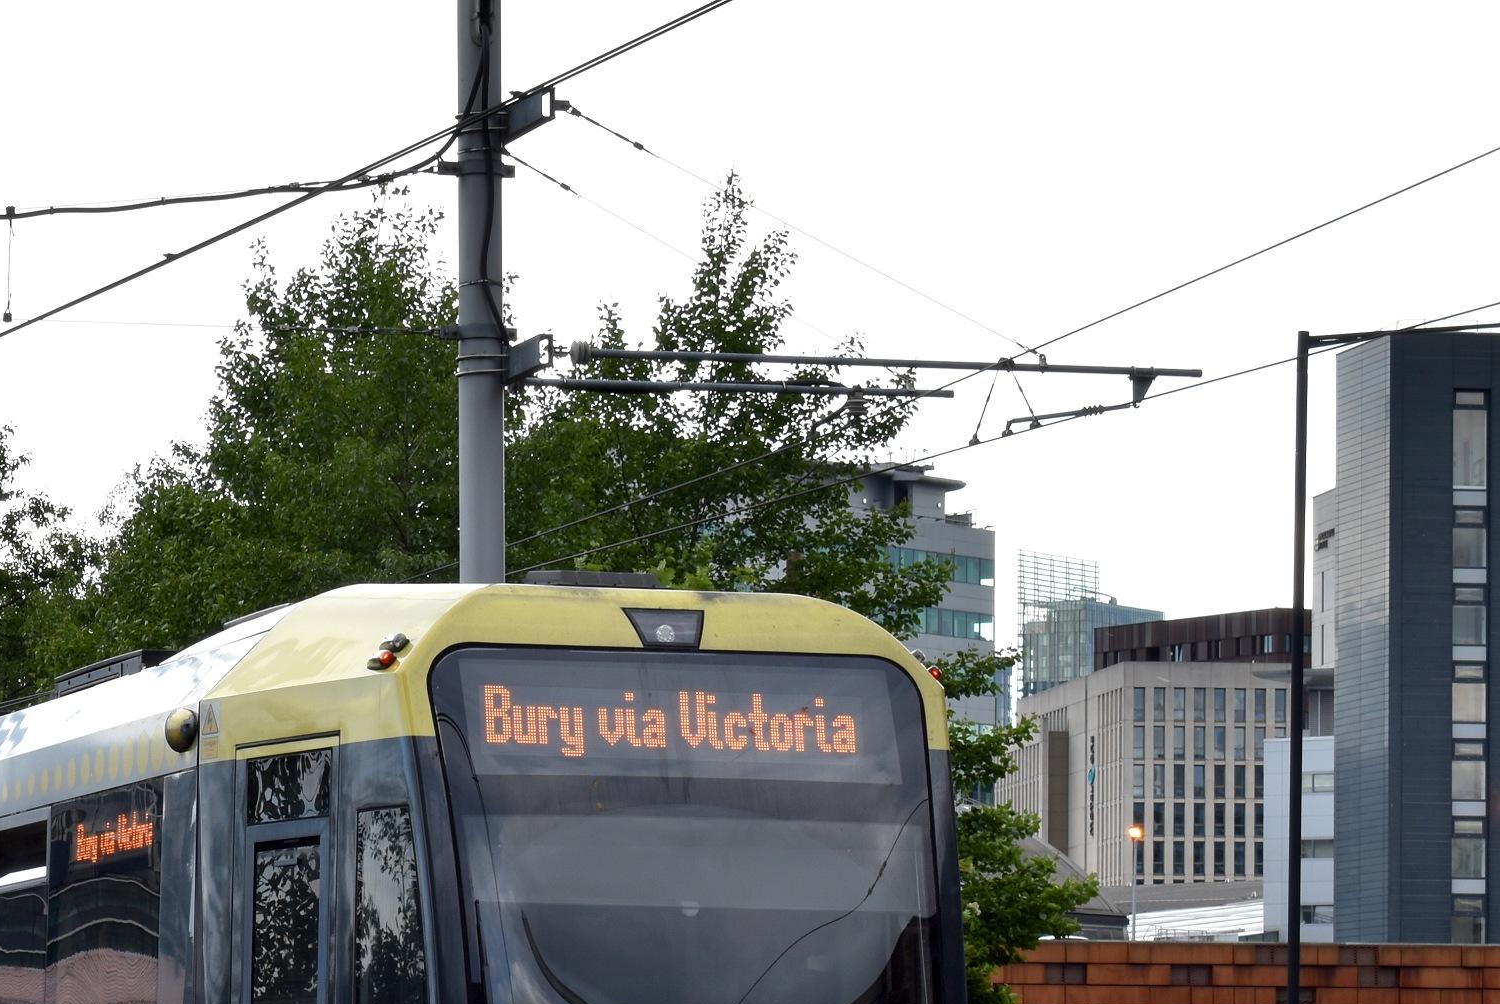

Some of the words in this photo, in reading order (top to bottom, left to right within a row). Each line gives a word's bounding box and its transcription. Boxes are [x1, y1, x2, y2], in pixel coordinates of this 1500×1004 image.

[484, 684, 585, 757] Bury
[598, 692, 667, 748] via
[679, 691, 856, 753] Victoria
